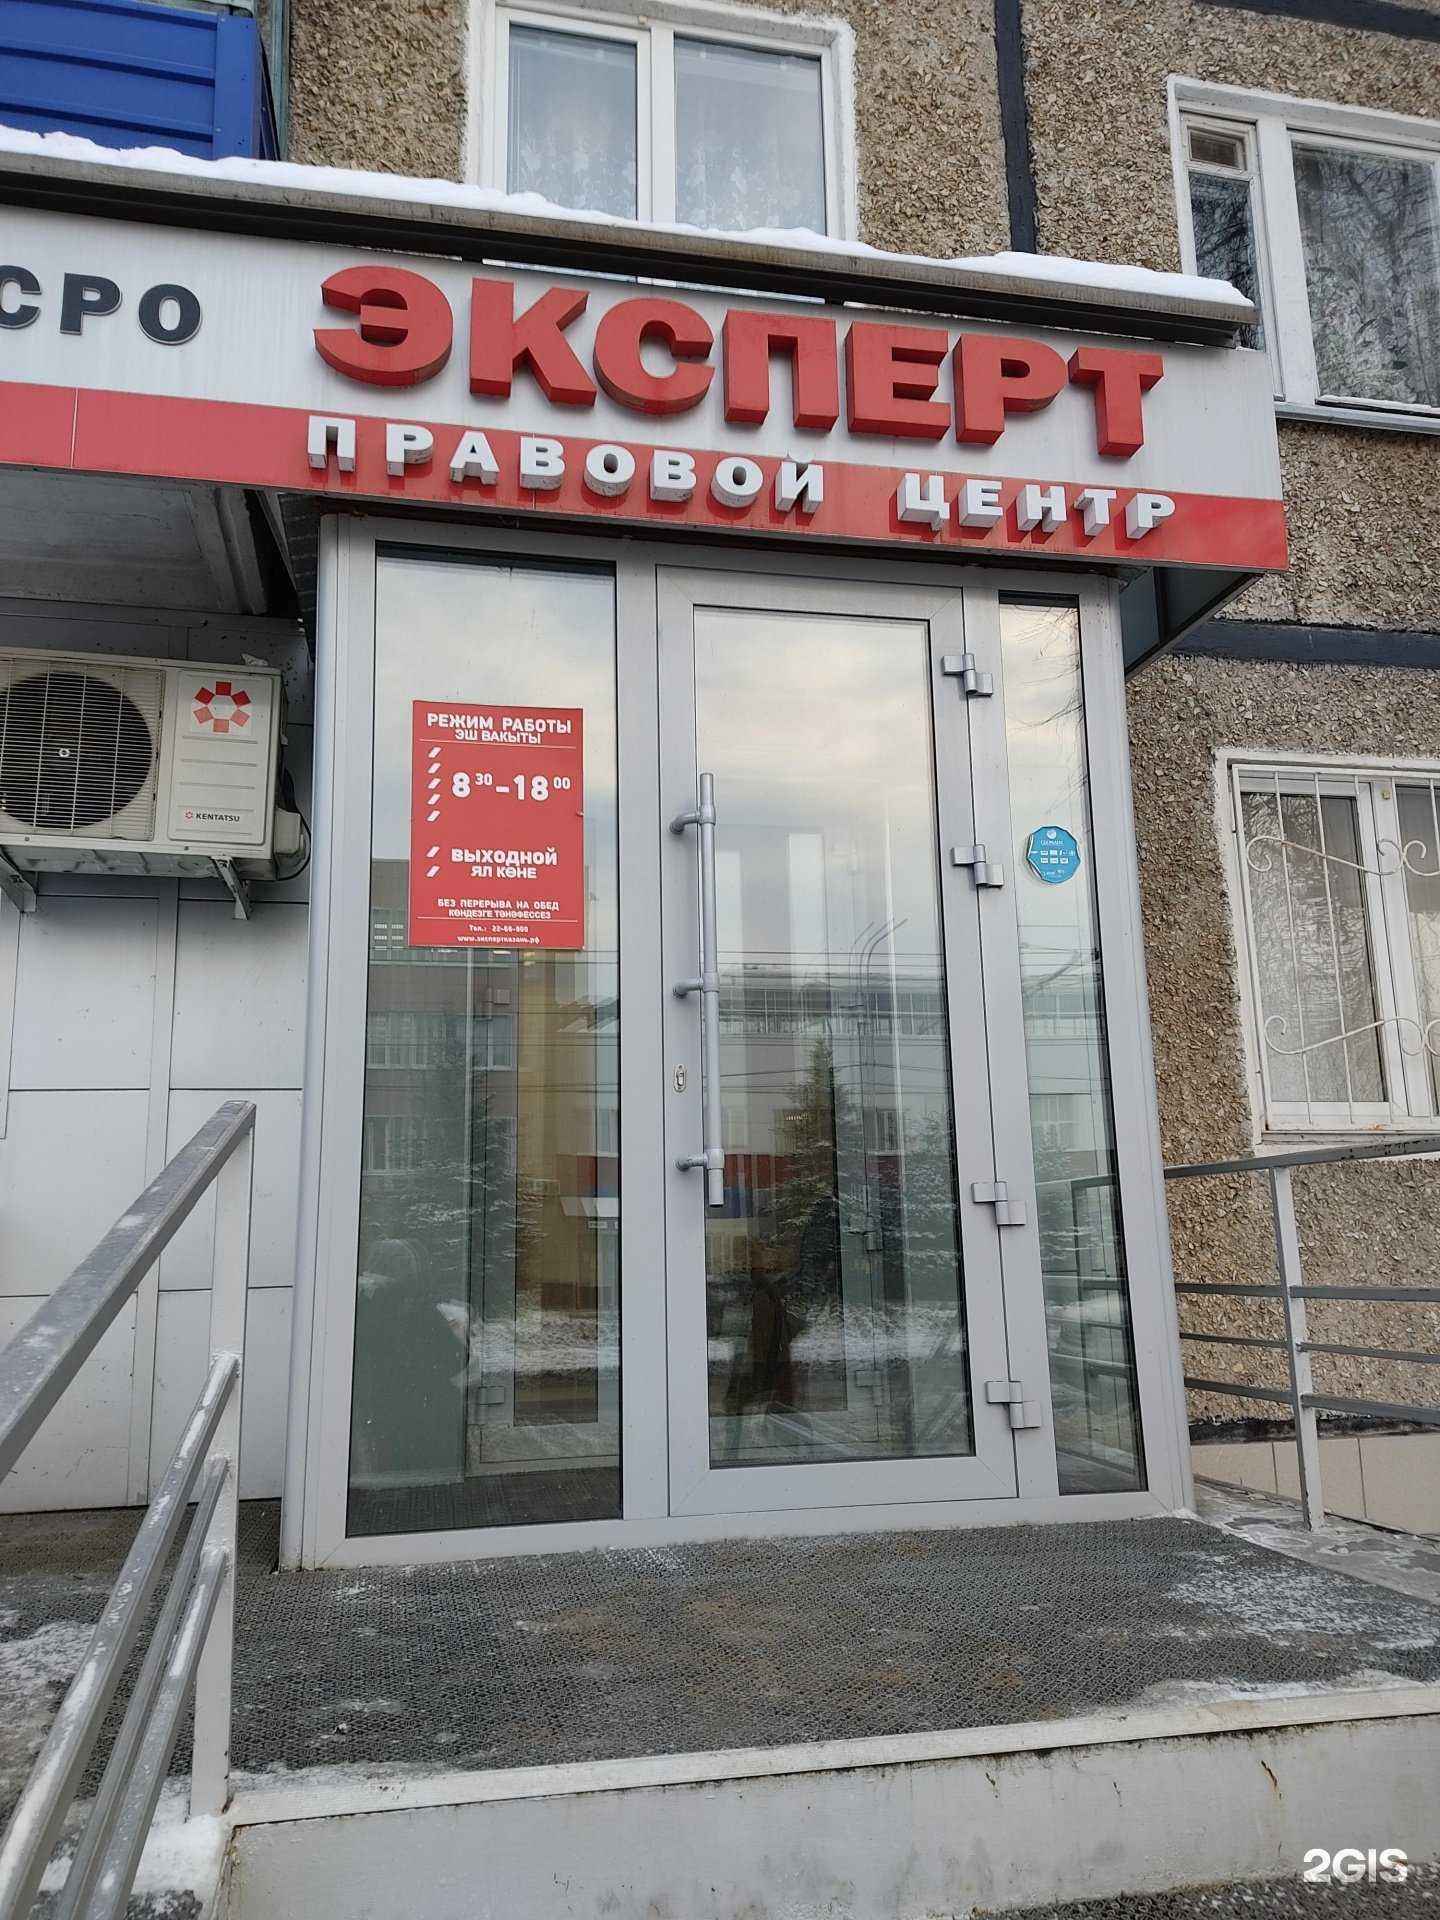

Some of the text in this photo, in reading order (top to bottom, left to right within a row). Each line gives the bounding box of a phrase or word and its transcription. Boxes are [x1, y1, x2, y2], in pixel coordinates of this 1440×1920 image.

[0, 264, 202, 346] СРО
[313, 264, 1164, 457] ЭКСПЕРТ
[307, 415, 1176, 541] ПРАВОВОЙ ЦЕНТР
[427, 713, 572, 734] РЕЖИМ РАБОТЫ
[455, 729, 541, 745] ЭШ ВАКЫТЫ
[196, 813, 240, 822] KENTATSU
[451, 846, 558, 866] ВЫХОДНОЙ
[471, 866, 492, 878] ЯЛ
[437, 899, 560, 911] БЕЗ ПЕРЕРЫВА НА ОБЕД
